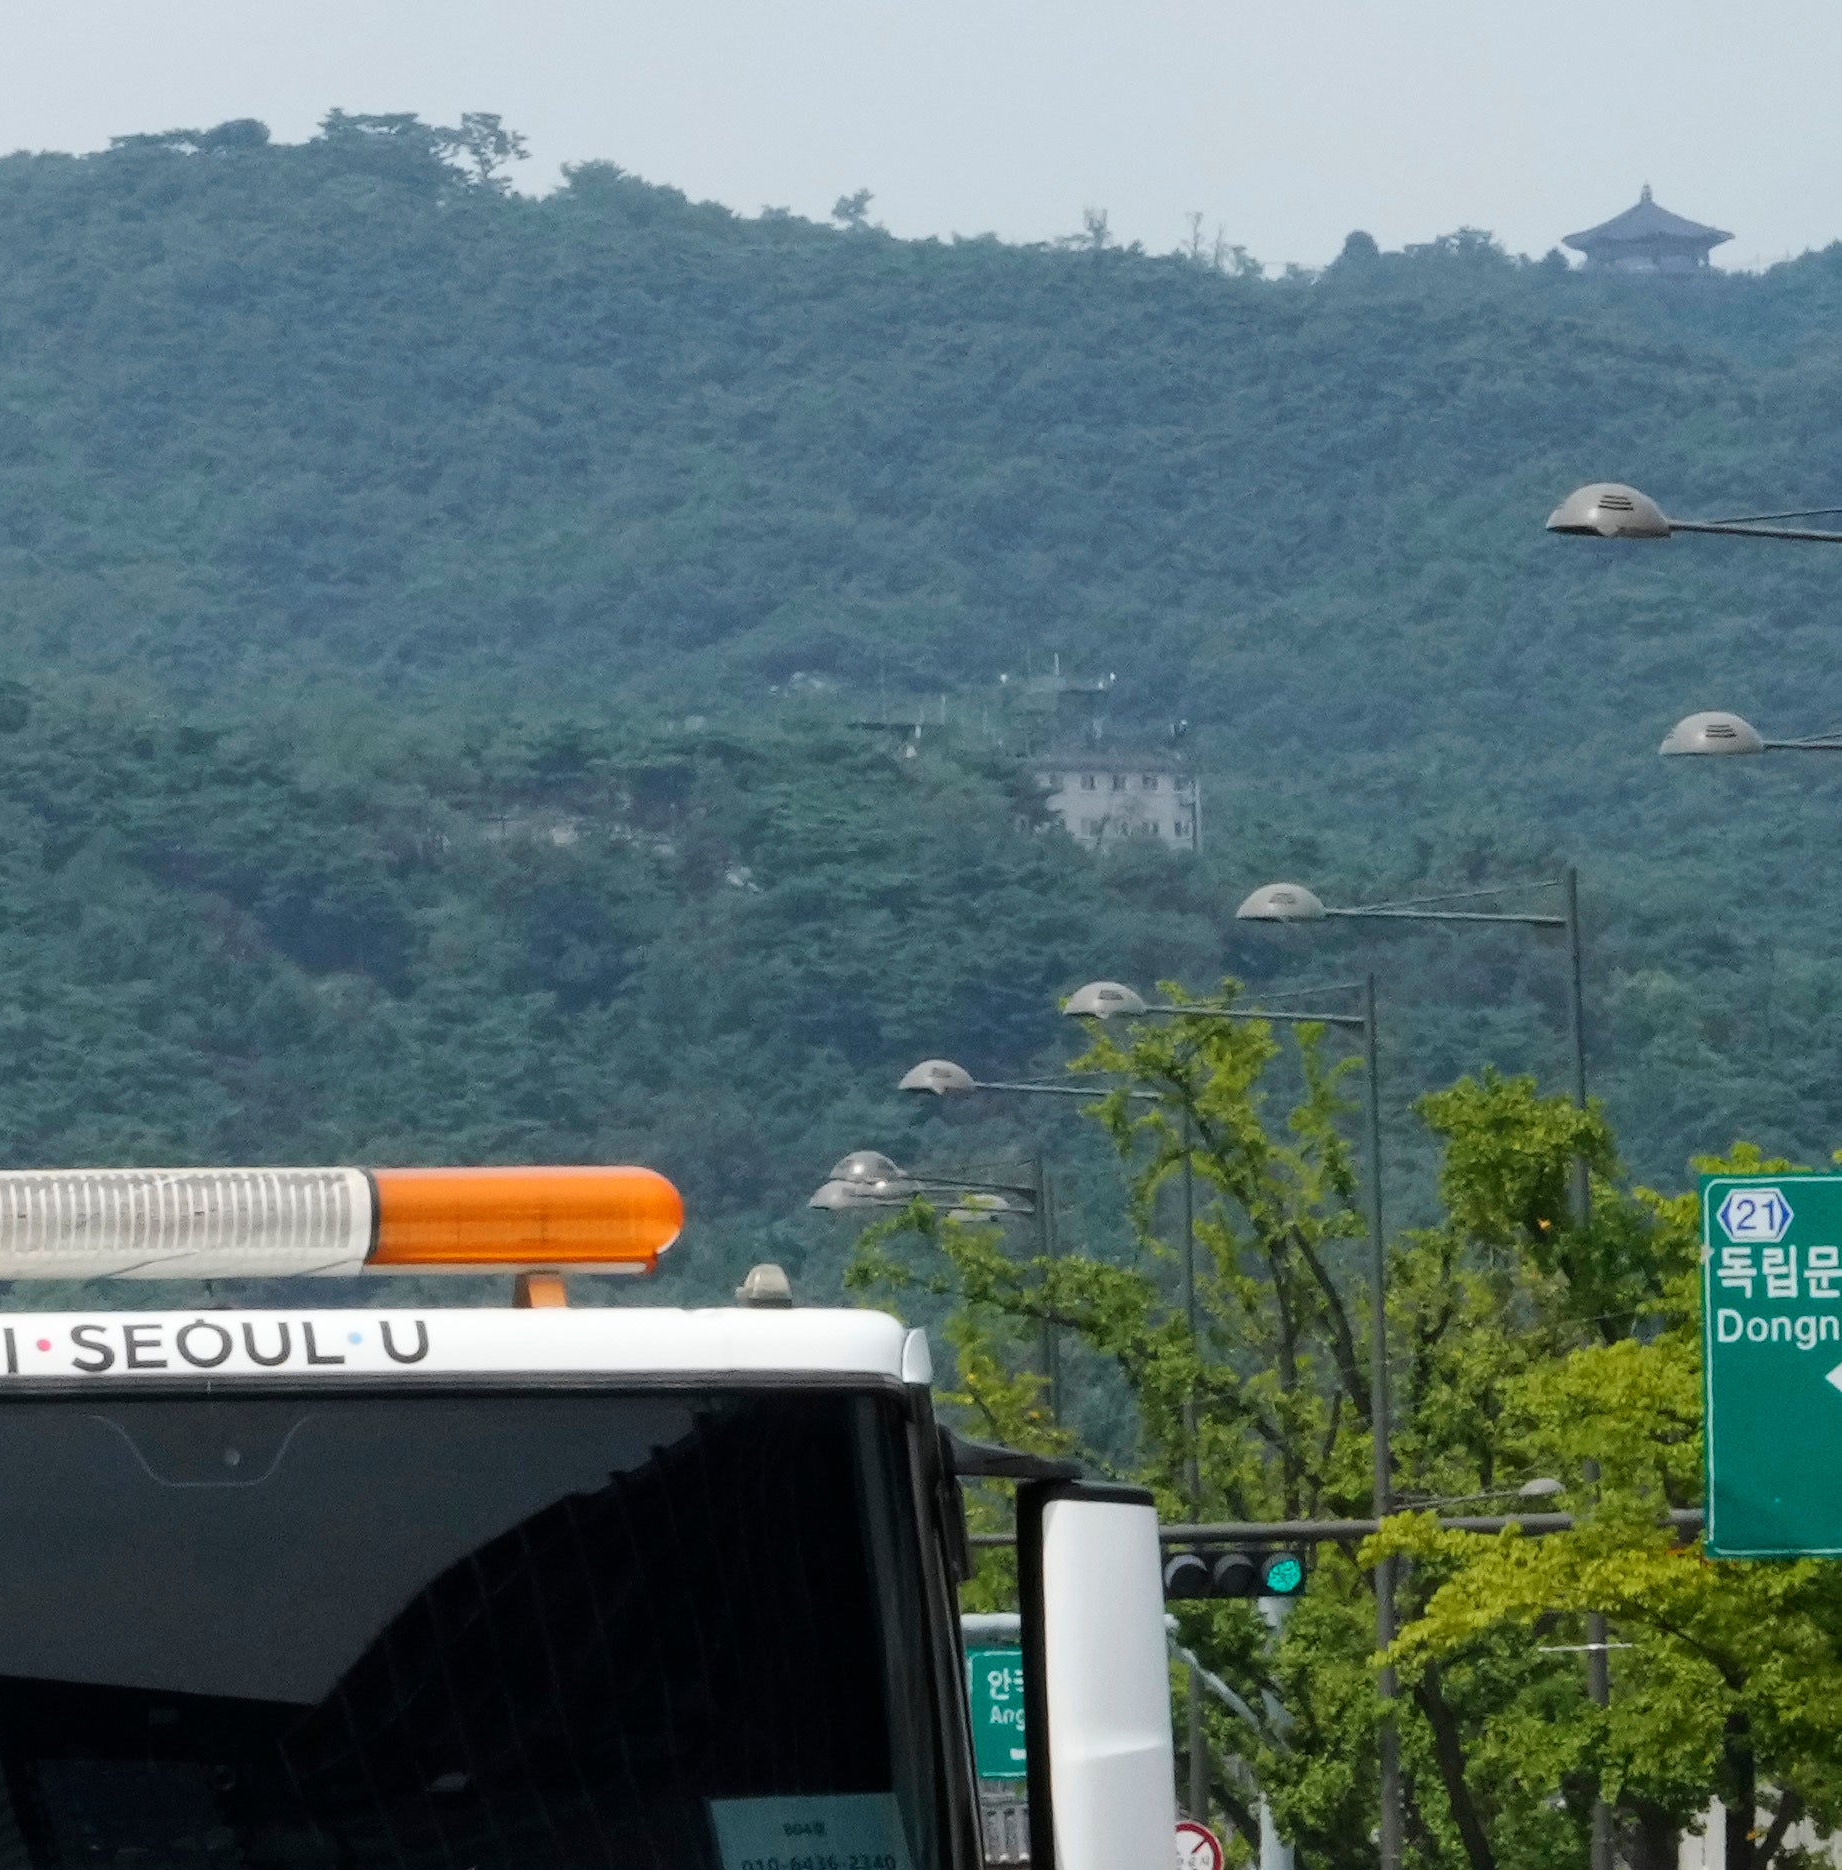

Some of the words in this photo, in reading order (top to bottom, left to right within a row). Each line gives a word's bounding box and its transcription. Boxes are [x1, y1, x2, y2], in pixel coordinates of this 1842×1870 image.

[1736, 1199, 1776, 1231] 21
[1717, 1244, 1842, 1299] 독립문
[1717, 1308, 1840, 1351] Dongn
